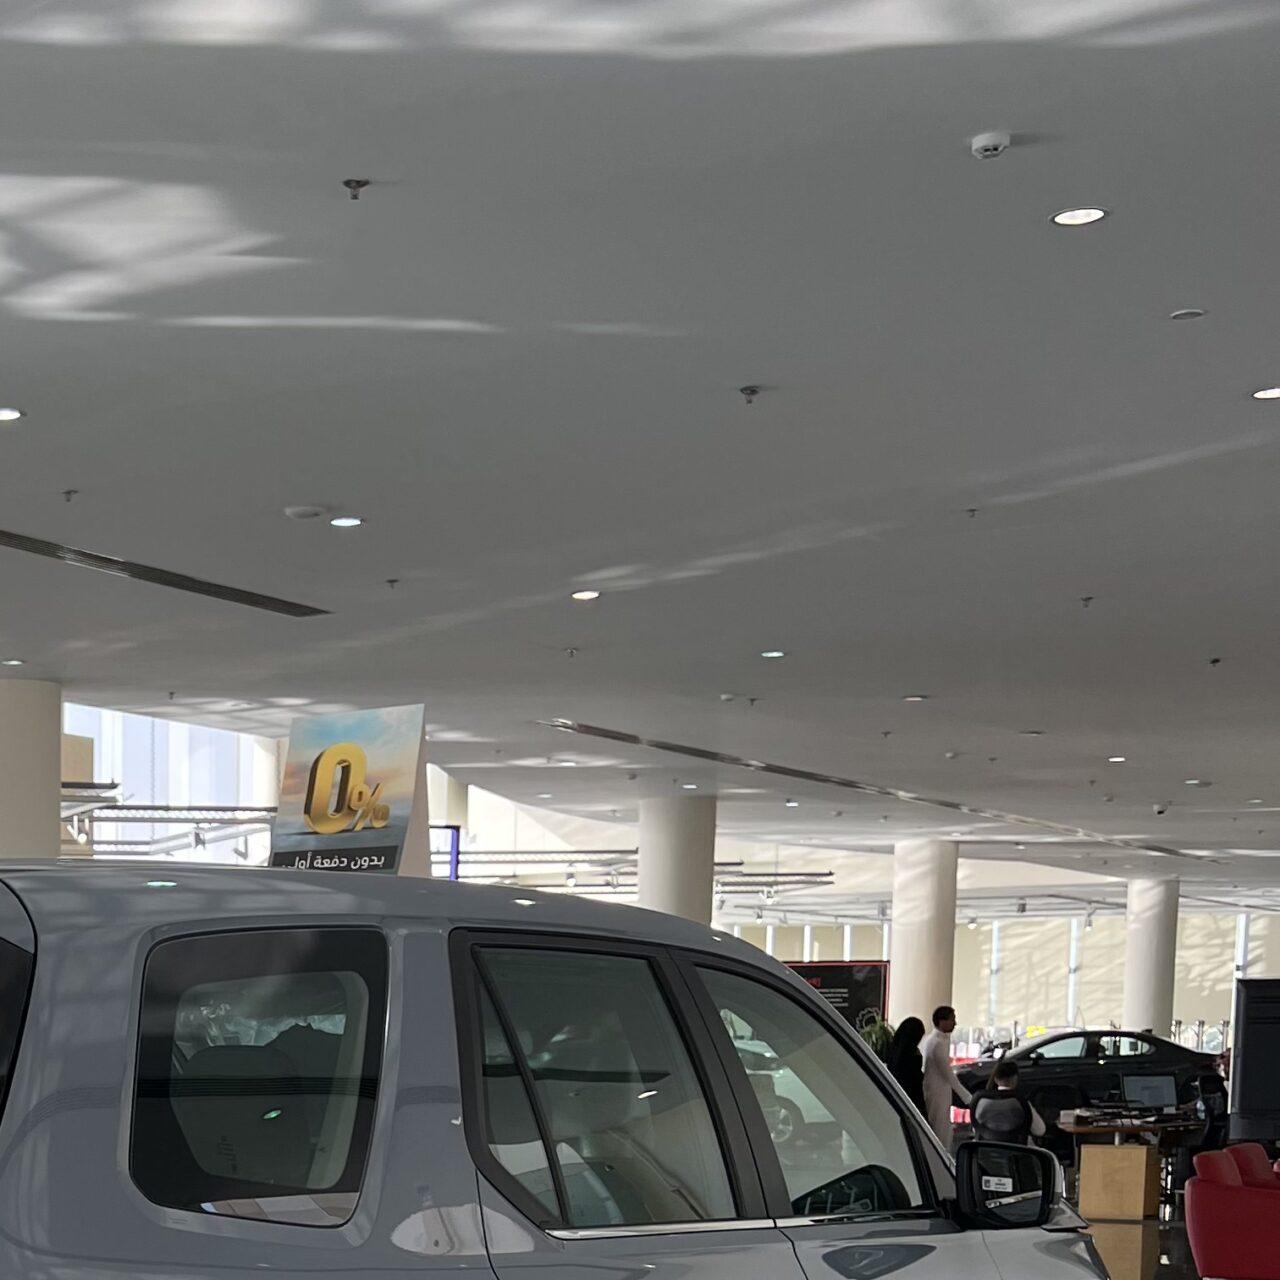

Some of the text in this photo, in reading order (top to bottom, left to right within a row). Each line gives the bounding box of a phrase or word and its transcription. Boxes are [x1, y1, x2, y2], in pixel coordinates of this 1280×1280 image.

[304, 742, 390, 834] 0%
[313, 854, 347, 868] دفعة
[350, 854, 385, 869] بدون
